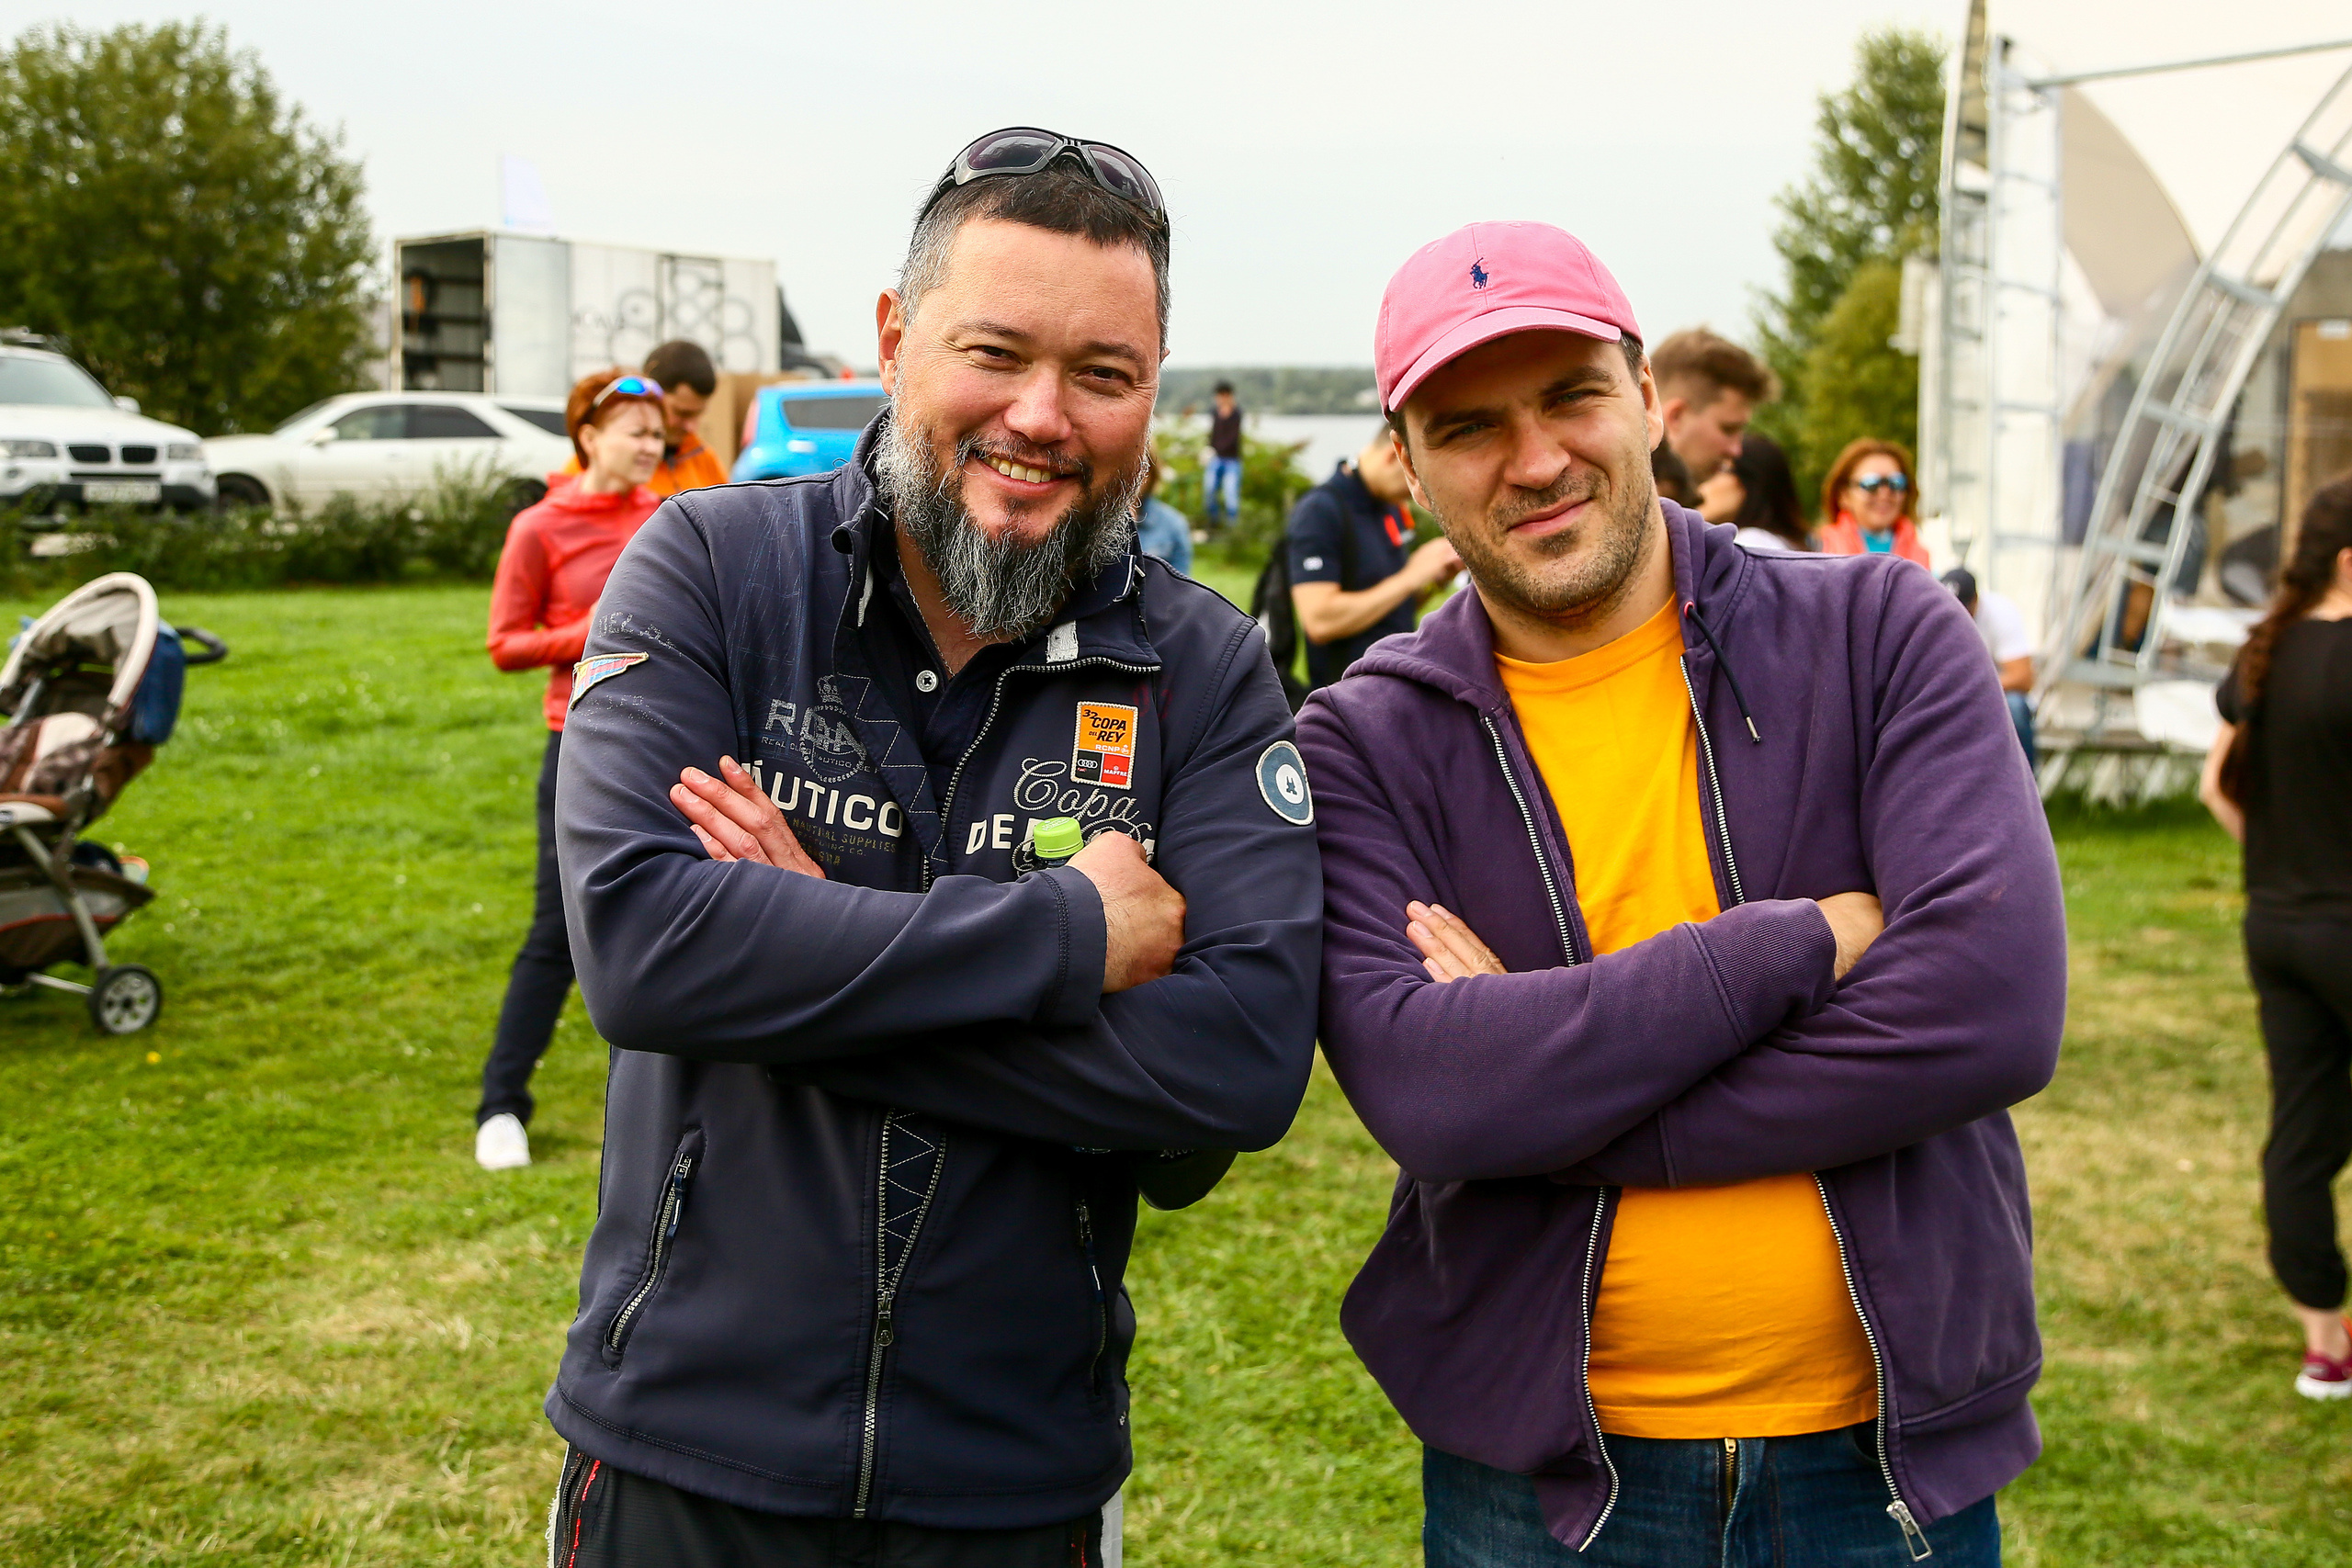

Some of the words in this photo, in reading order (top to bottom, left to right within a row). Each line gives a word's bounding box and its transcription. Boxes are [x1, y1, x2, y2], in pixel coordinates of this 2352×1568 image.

[1082, 709, 1098, 719] 32
[1091, 716, 1127, 731] COPA
[762, 737, 786, 748] REAL
[1096, 730, 1125, 743] REY
[1095, 744, 1121, 752] RCNP
[1013, 758, 1139, 820] Copa
